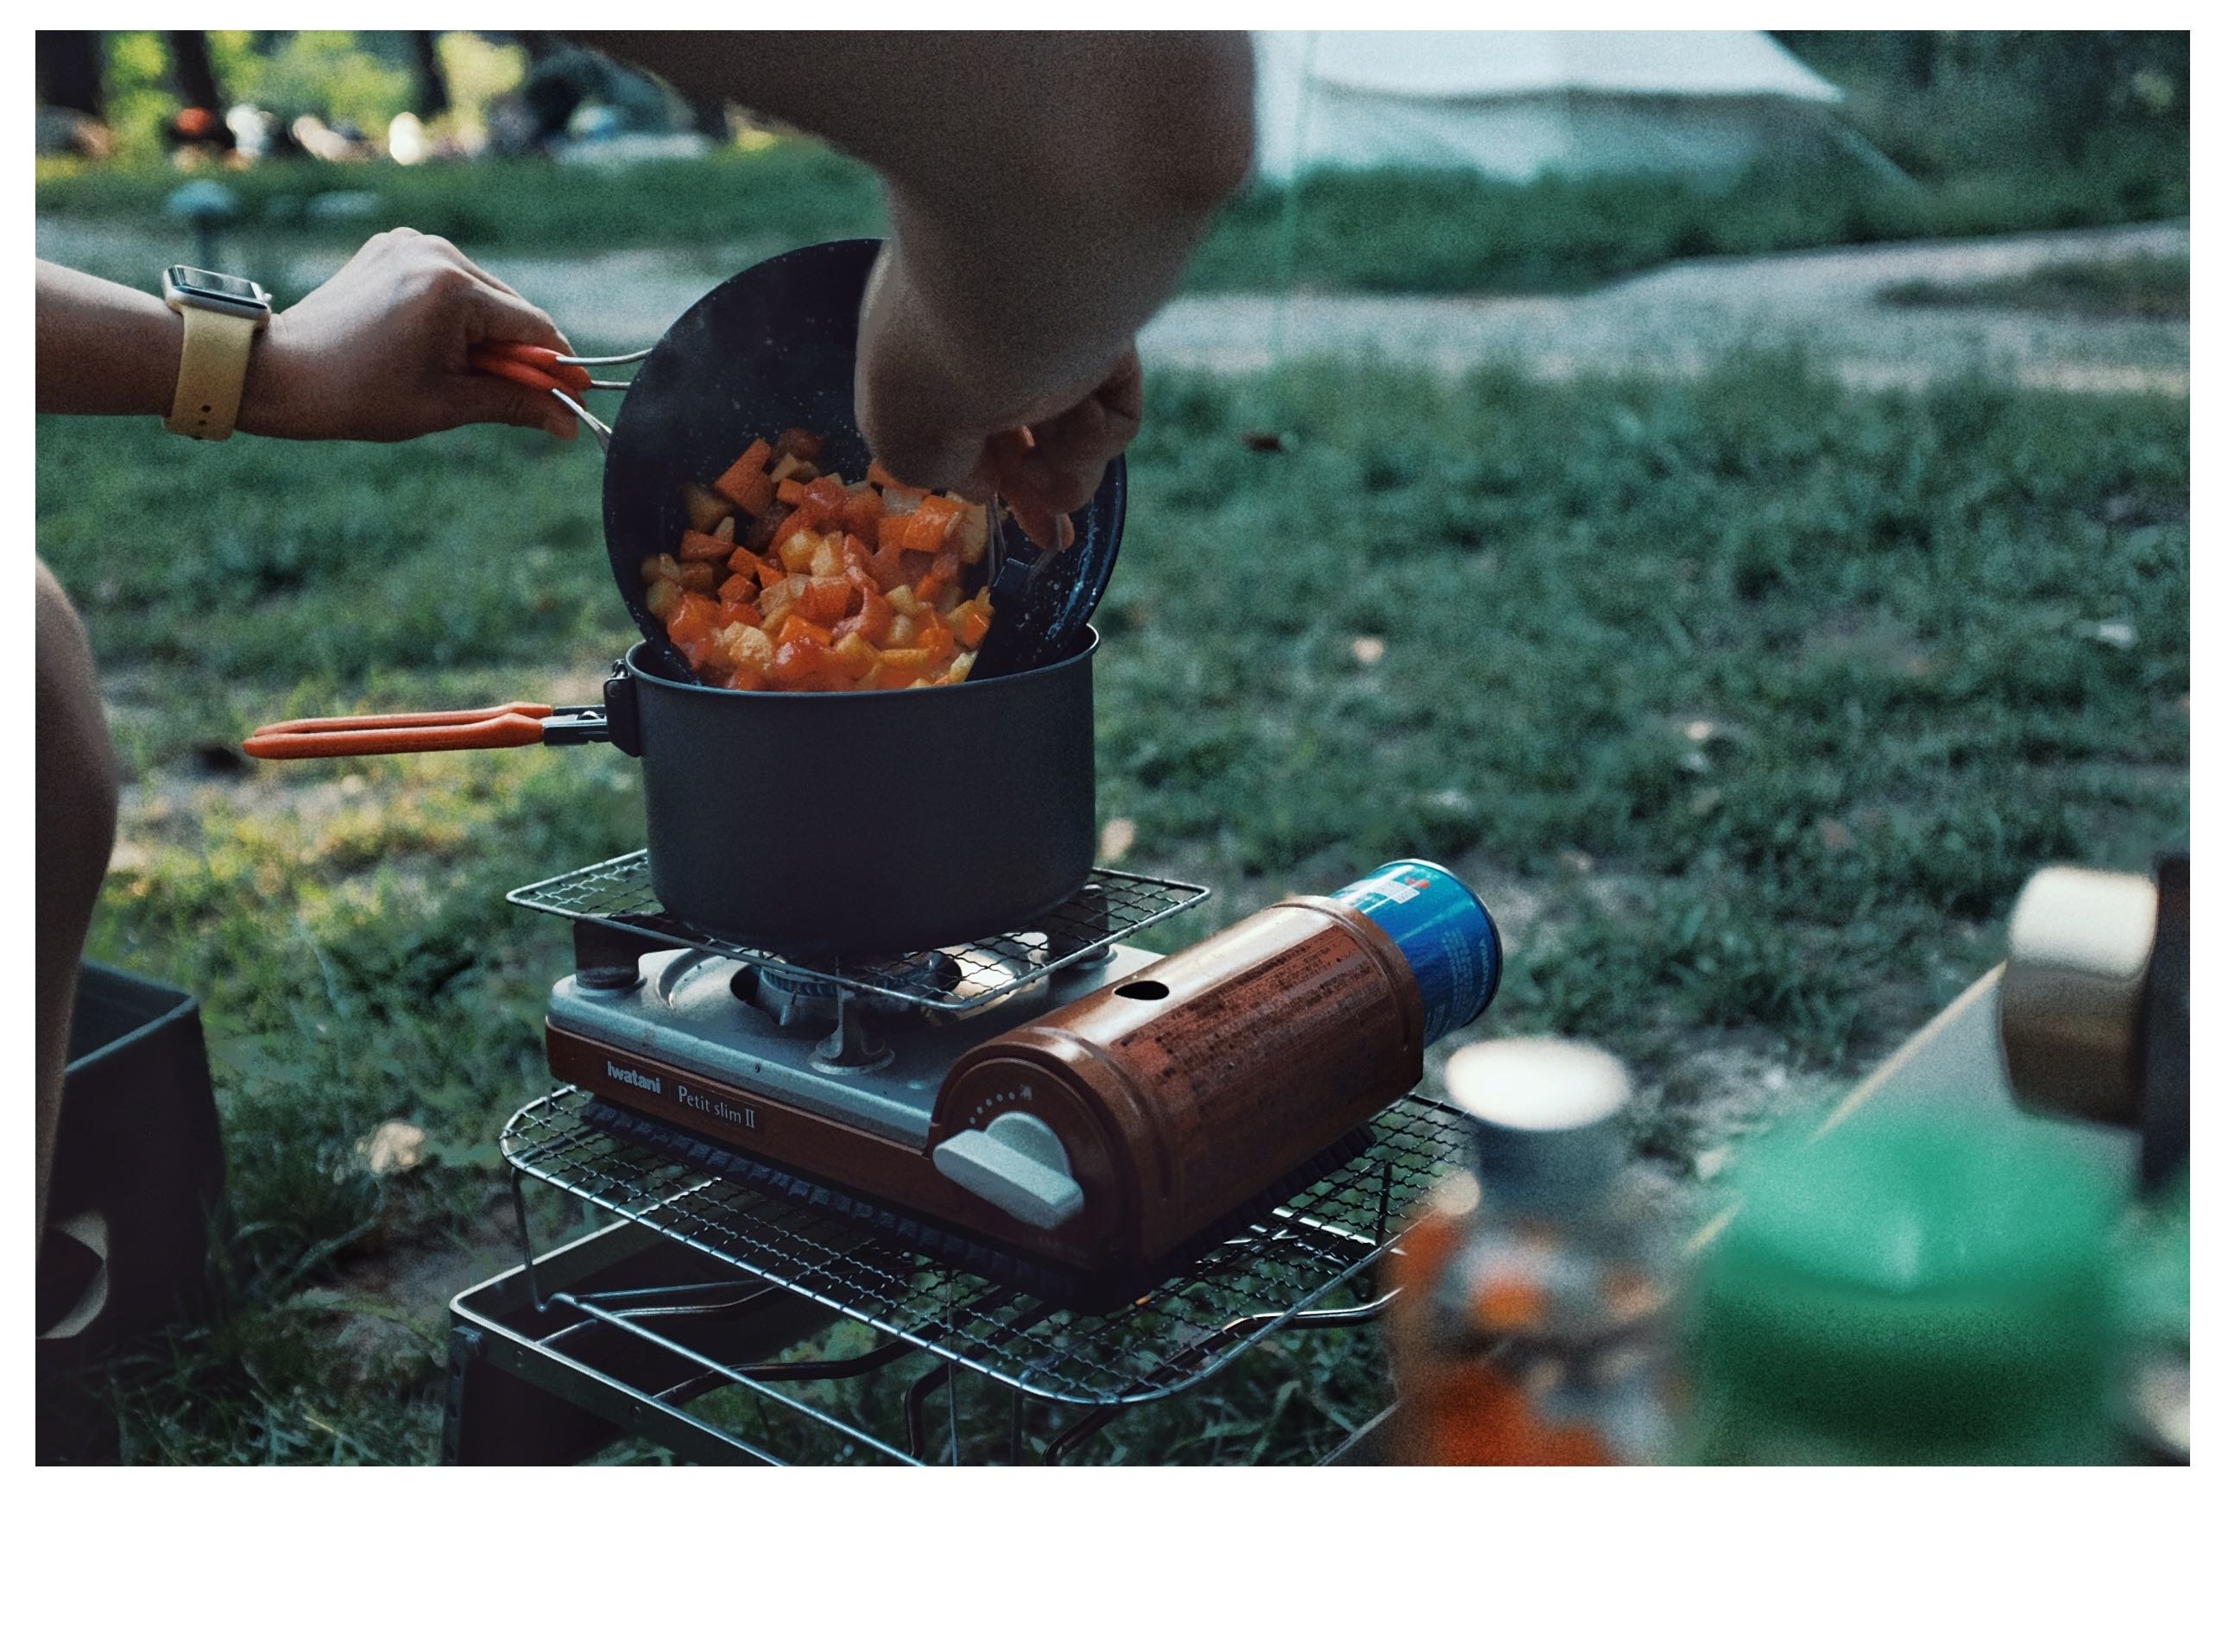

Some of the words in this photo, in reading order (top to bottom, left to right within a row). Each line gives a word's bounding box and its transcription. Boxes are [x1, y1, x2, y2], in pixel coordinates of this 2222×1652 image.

[607, 1061, 660, 1094] Iwatani
[678, 1085, 710, 1112] Petit
[714, 1102, 742, 1123] slim
